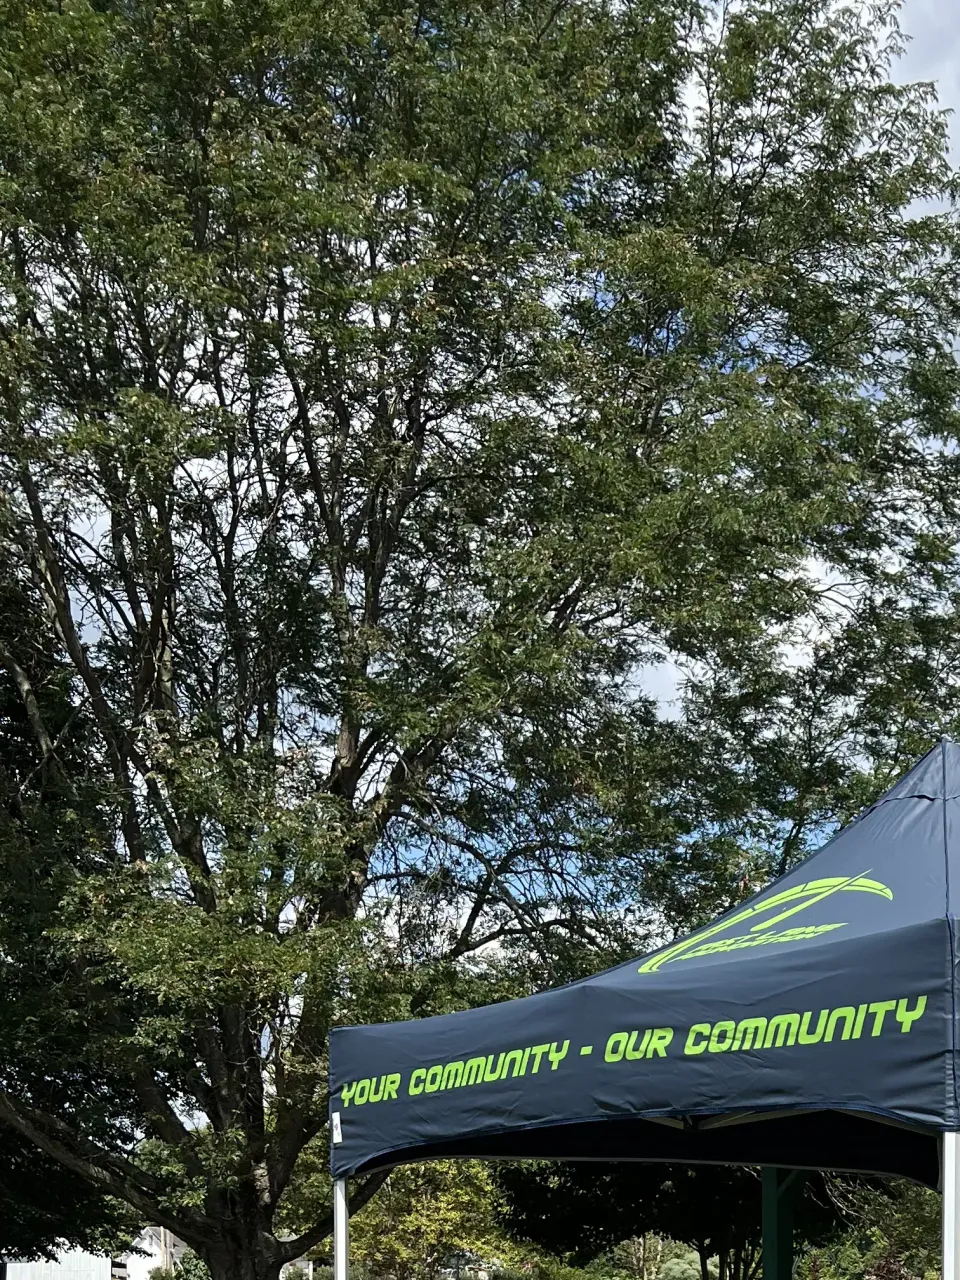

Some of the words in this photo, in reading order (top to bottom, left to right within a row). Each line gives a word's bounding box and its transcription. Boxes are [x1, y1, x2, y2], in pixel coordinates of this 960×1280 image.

[341, 1074, 400, 1107] YOUR
[408, 1041, 570, 1096] COMMUNITY
[580, 1047, 592, 1056] -
[604, 1028, 673, 1063] OUR
[685, 996, 927, 1056] COMMUNITY
